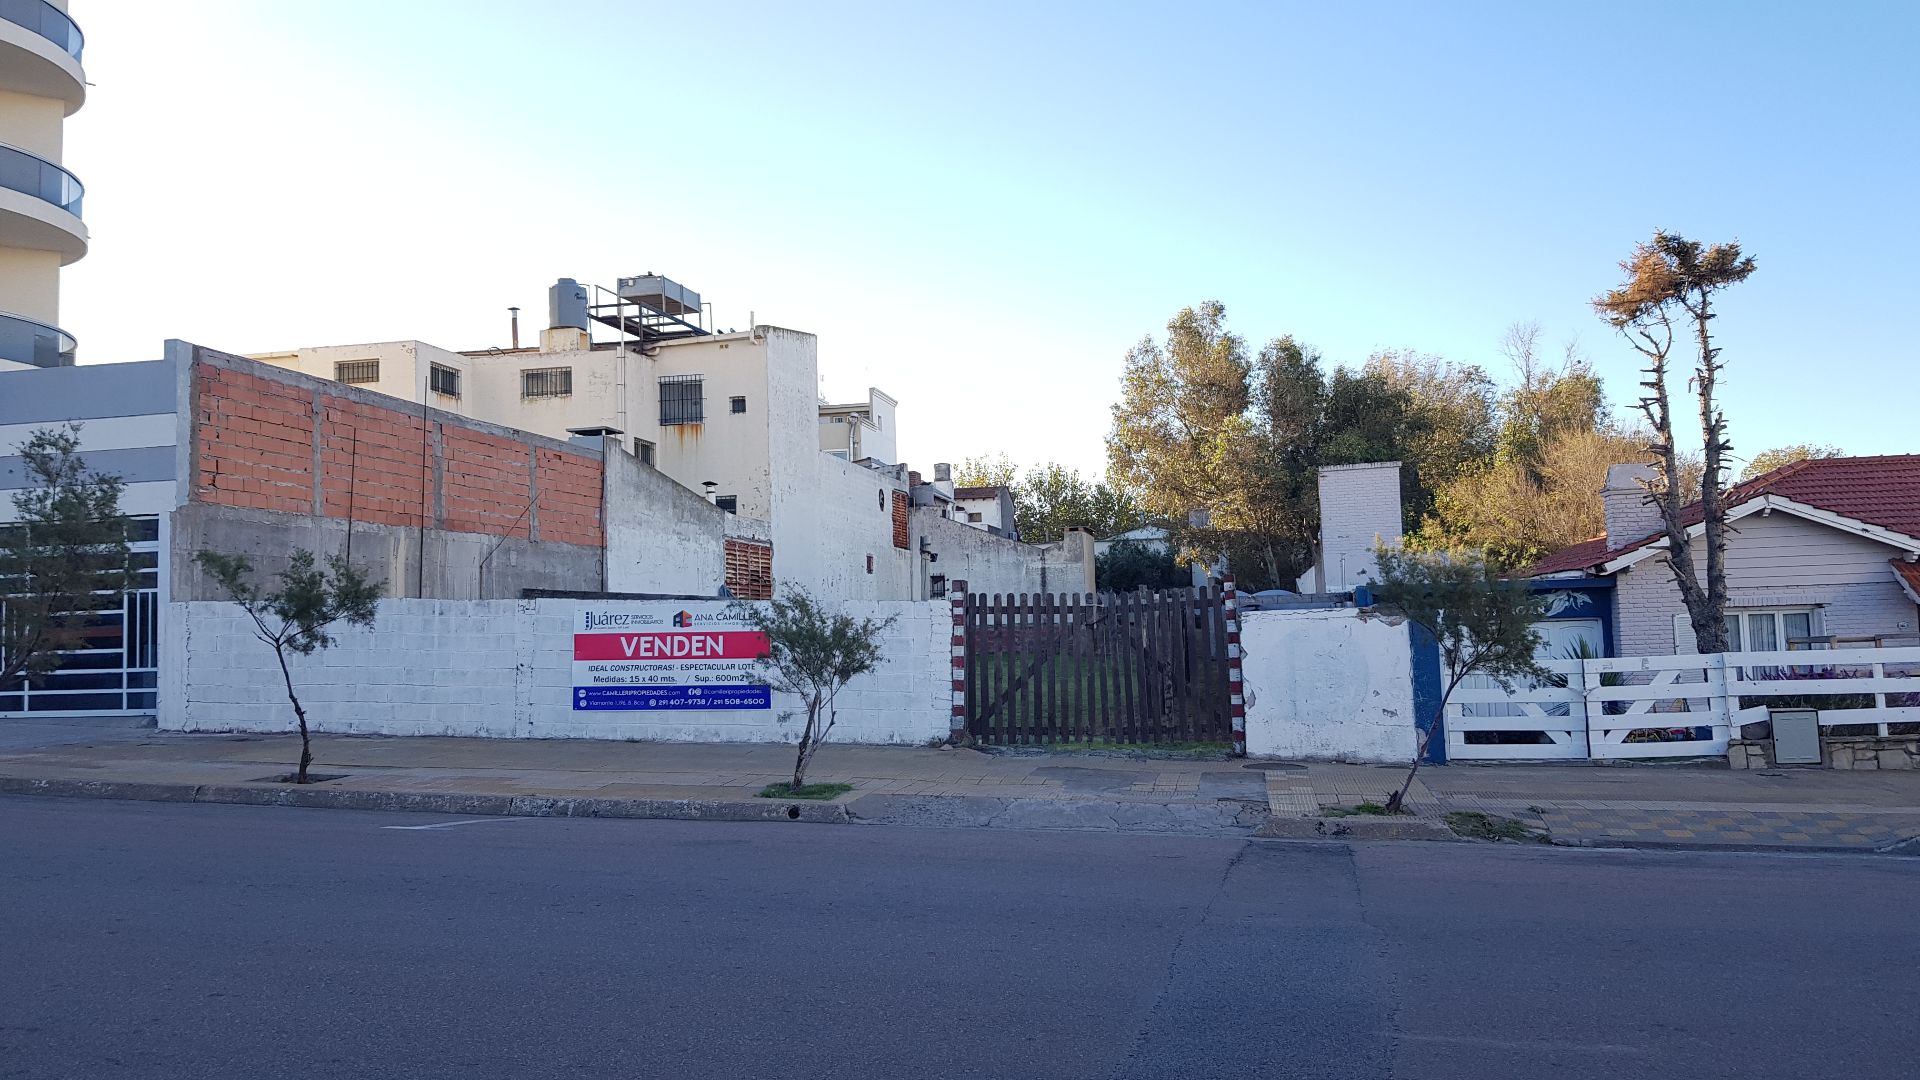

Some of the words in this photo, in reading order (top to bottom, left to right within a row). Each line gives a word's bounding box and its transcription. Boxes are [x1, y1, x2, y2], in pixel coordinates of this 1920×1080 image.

[590, 611, 630, 630] Juárez
[694, 613, 714, 621] ANA
[620, 635, 724, 657] VENDEN
[588, 664, 609, 672] IDEAL
[610, 664, 675, 672] CONSTRUCTORAS!
[680, 663, 736, 671] ESPECTACULAR
[737, 663, 756, 671] LOTE
[593, 675, 628, 684] Medidas:
[629, 675, 640, 683] 15
[647, 675, 659, 683] 40
[660, 675, 678, 683] mts.
[694, 674, 714, 683] Sup.:
[670, 698, 706, 706] 407-9738
